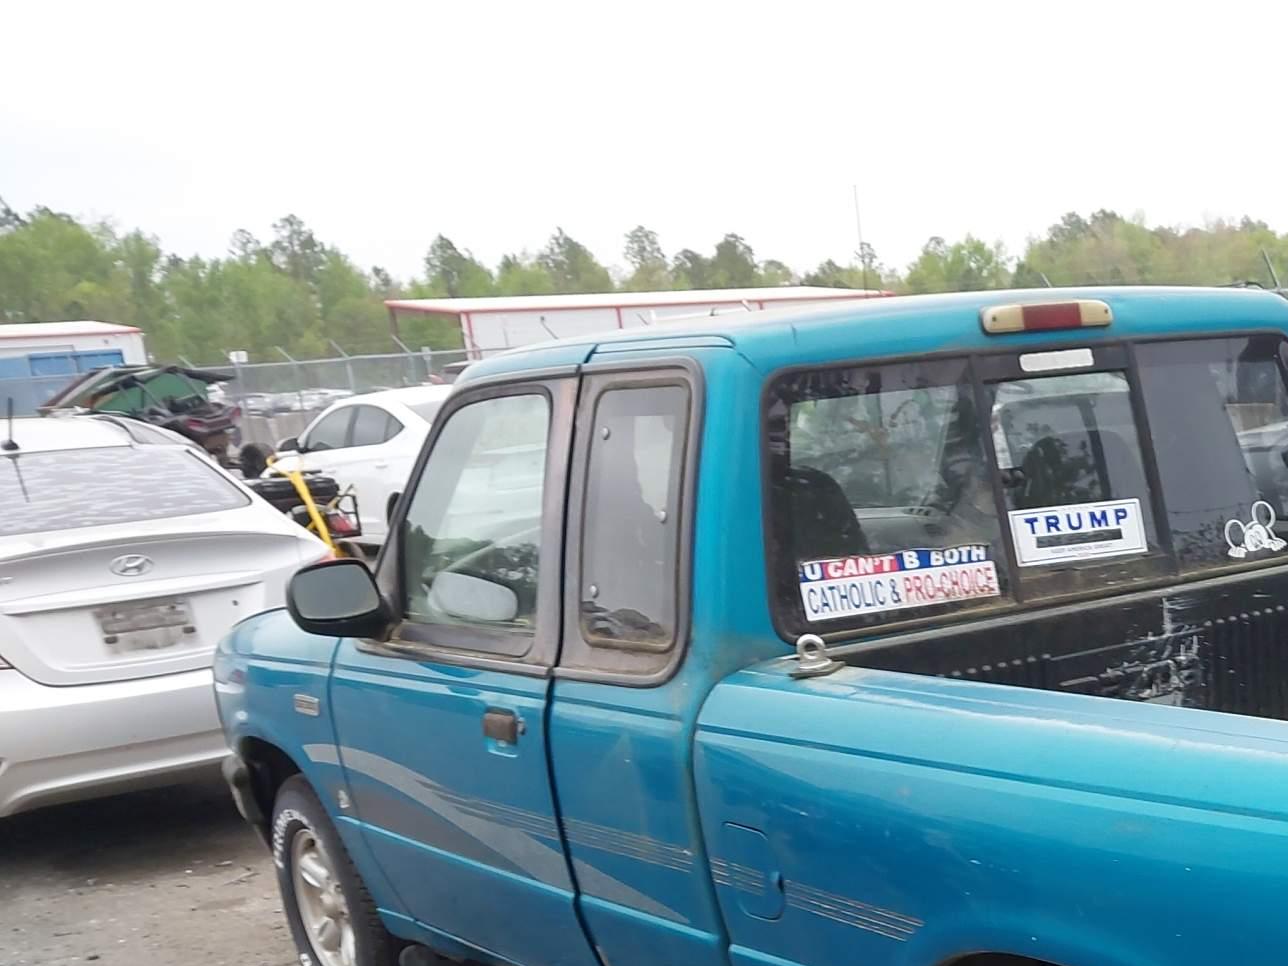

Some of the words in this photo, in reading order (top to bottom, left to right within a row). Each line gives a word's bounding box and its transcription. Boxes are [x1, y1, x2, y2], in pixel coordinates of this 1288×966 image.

[1024, 508, 1128, 534] TRUMP
[803, 563, 822, 580] U
[827, 556, 894, 578] CAN'T
[902, 551, 920, 570] B
[930, 545, 986, 566] BOTH
[807, 580, 886, 614] CATHOLIC
[890, 578, 902, 603] &
[904, 567, 995, 600] PRO-CHOICE
